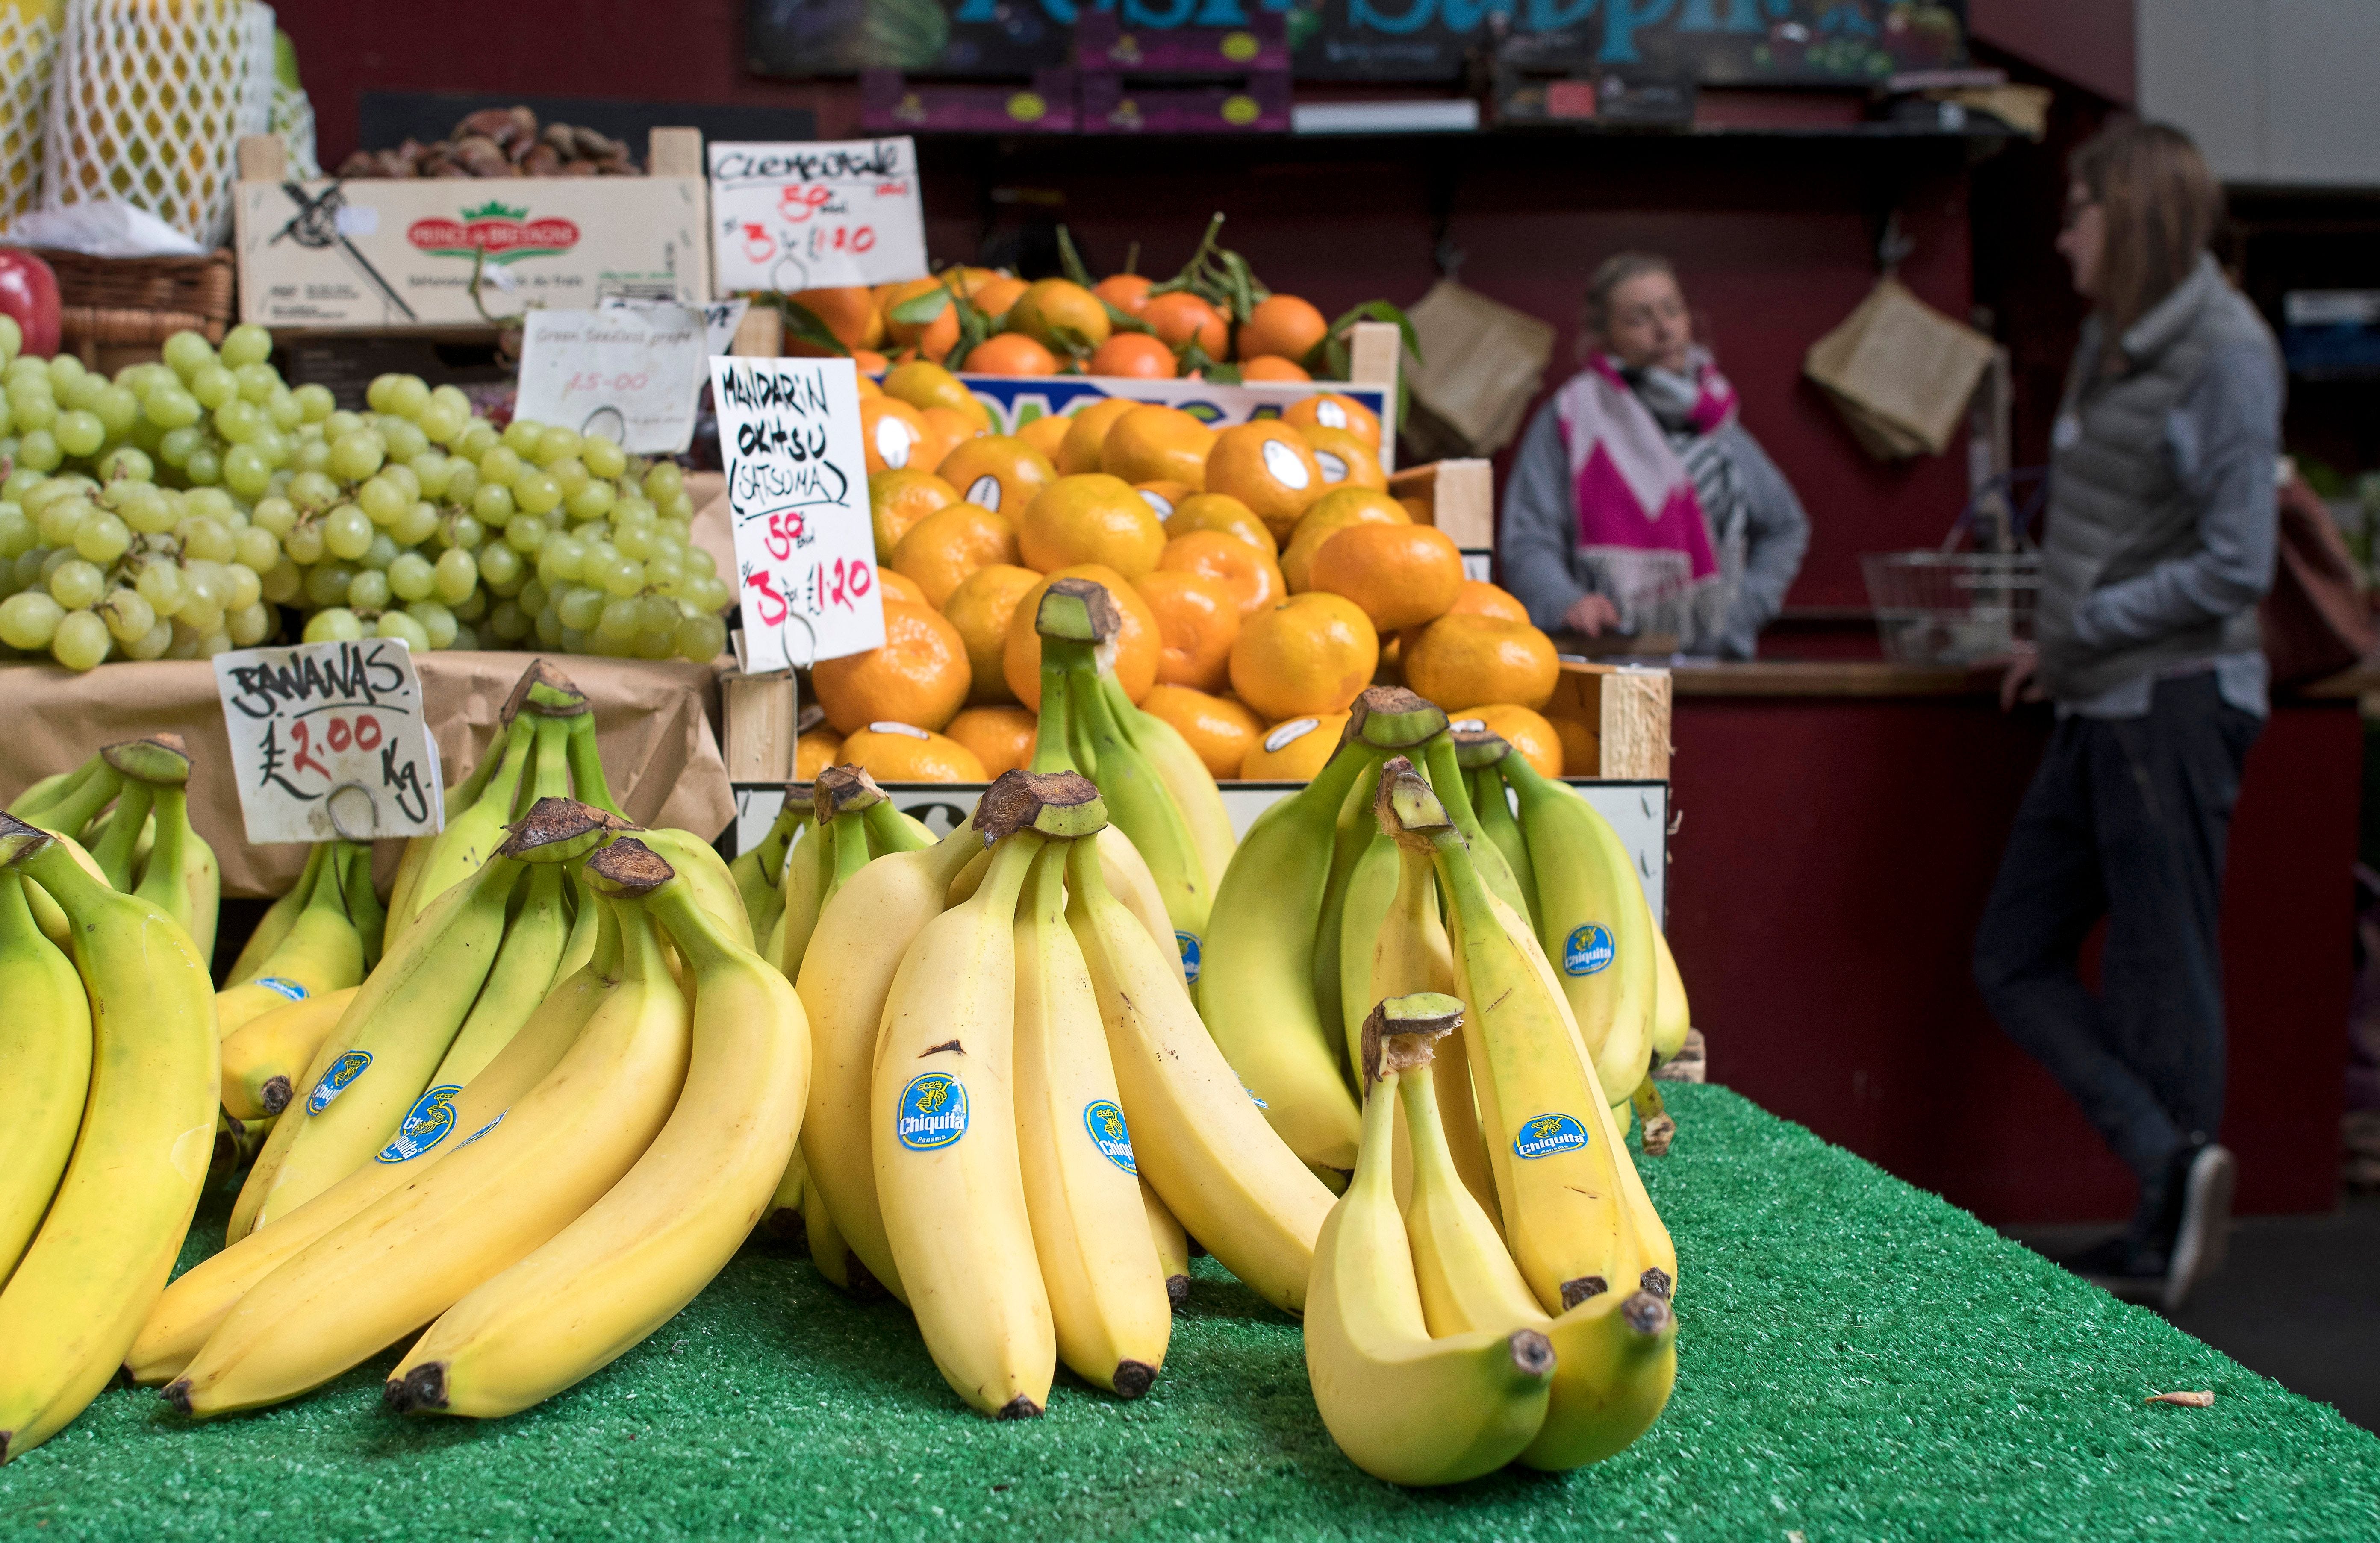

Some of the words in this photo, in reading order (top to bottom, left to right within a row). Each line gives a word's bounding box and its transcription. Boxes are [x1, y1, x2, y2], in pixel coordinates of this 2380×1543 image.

[748, 570, 787, 626] 3
[258, 714, 383, 801] £2.00
[1565, 947, 1612, 969] Chiquita
[899, 1111, 965, 1135] Chiquita
[917, 1135, 946, 1143] Panama
[1518, 1133, 1585, 1155] Chiquita
